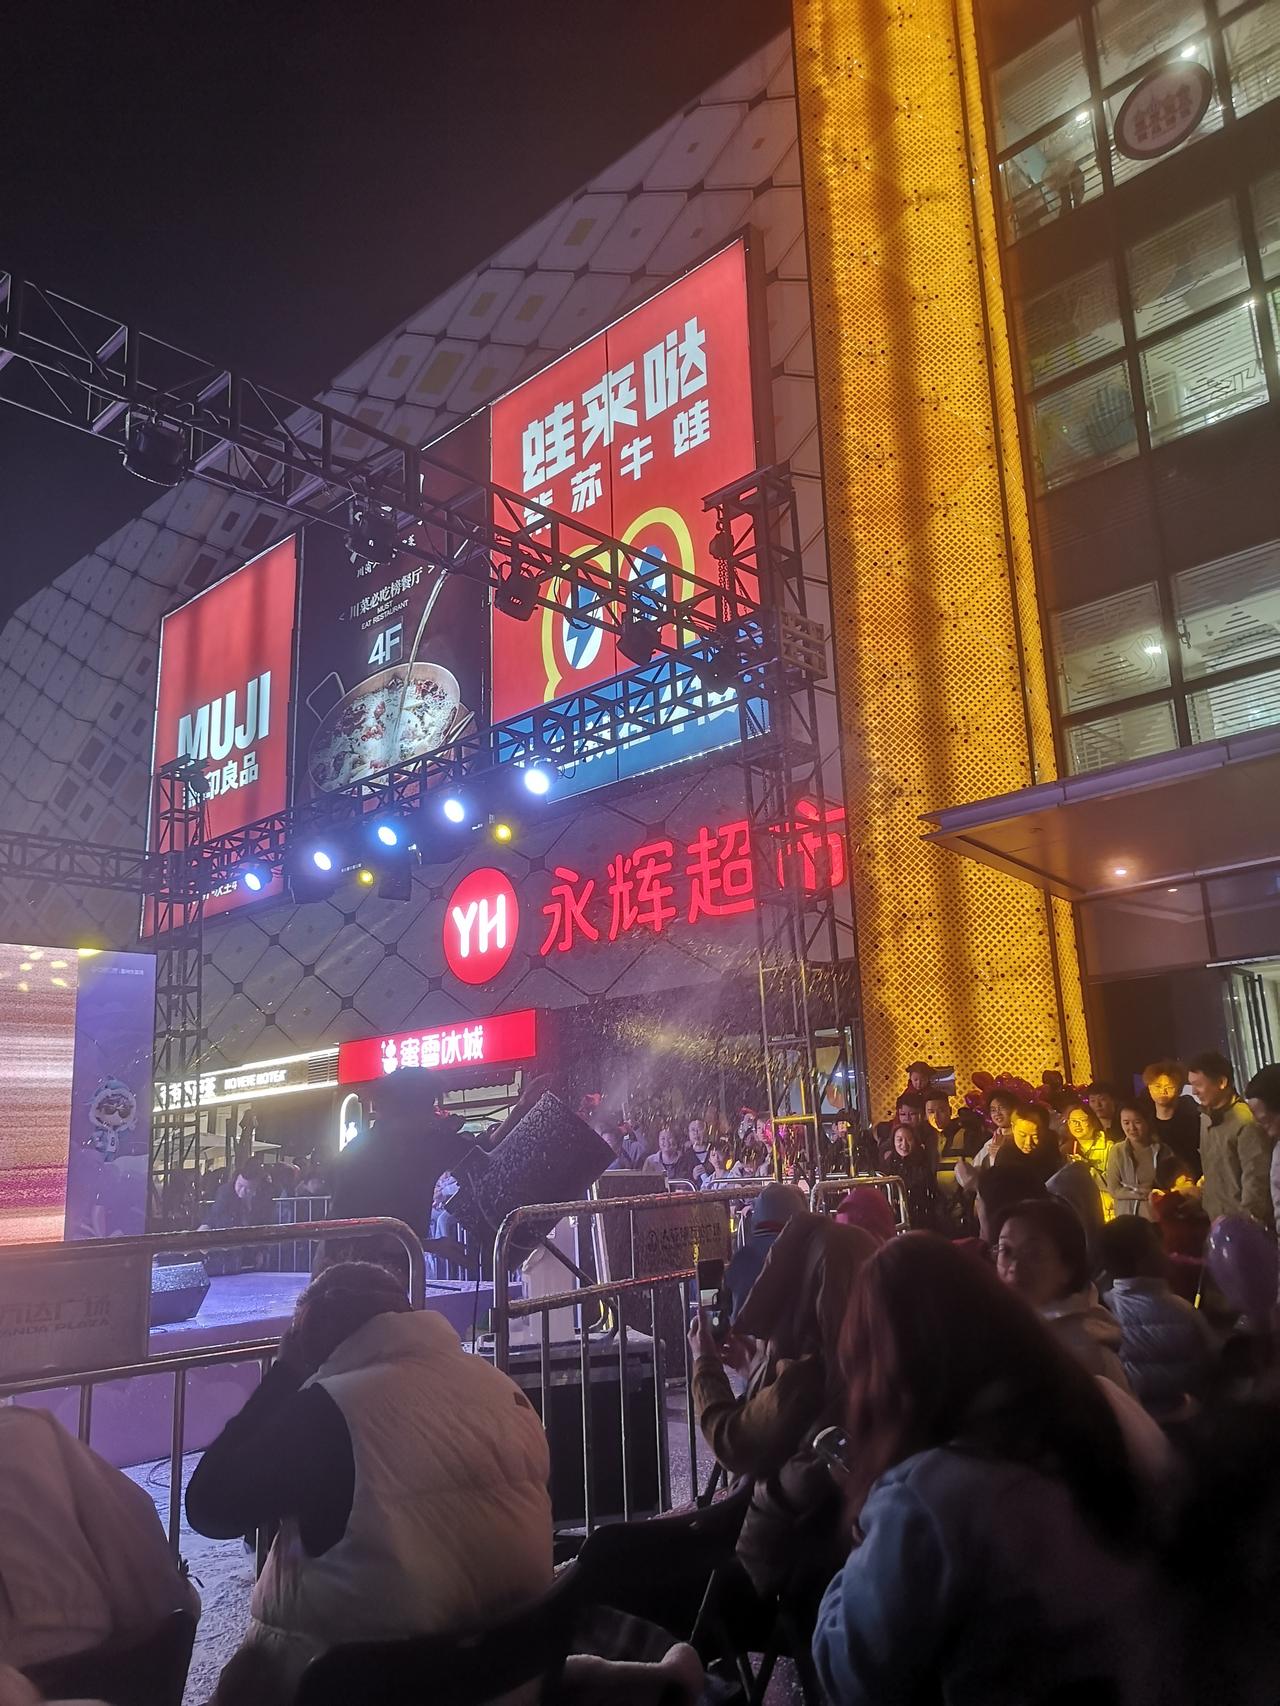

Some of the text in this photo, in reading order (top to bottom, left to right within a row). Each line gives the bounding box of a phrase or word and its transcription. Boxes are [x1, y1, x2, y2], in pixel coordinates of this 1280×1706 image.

[522, 316, 708, 493] 蛙来哒
[372, 599, 409, 624] RESTAURANT
[376, 600, 393, 614] MUST
[368, 623, 402, 666] 4F
[177, 670, 271, 767] MUJI
[539, 800, 847, 956] 永辉超市
[452, 894, 506, 959] YH
[400, 1025, 484, 1069] 蜜雪冰城
